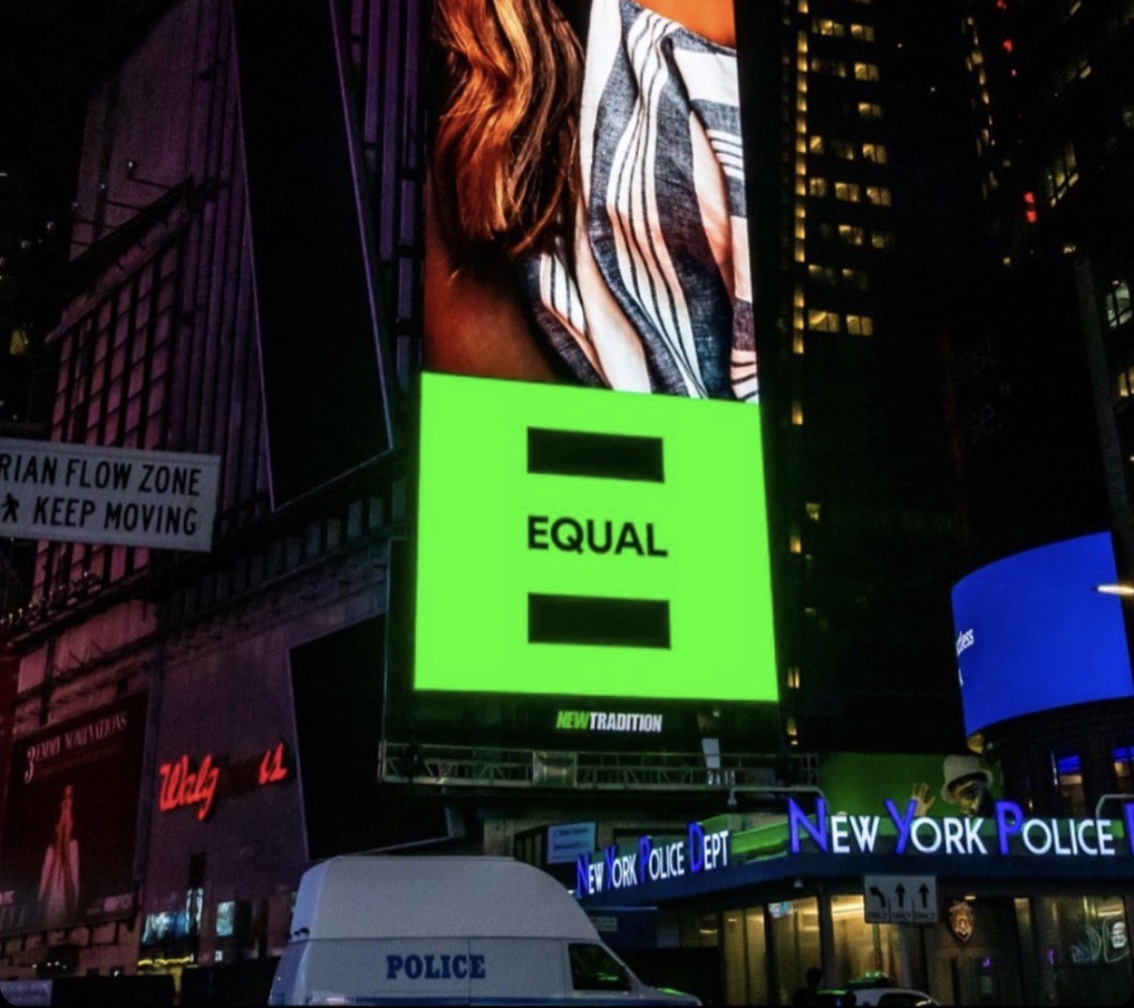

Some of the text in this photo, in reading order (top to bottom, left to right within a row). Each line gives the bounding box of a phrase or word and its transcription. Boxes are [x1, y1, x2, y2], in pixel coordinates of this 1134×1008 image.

[0, 453, 202, 496] RIAN FLOW ZONE
[32, 496, 199, 536] KEEP MOVING
[527, 515, 669, 557] EQUAL
[556, 710, 663, 733] NEWTRADITION
[788, 796, 880, 855] NEW
[884, 796, 989, 855] YORK
[994, 801, 1117, 857] POLICE
[575, 852, 604, 899] NEW
[604, 844, 638, 891] YORK
[639, 834, 685, 885] POLICE
[688, 821, 730, 874] DEPT
[386, 954, 486, 980] POLICE
